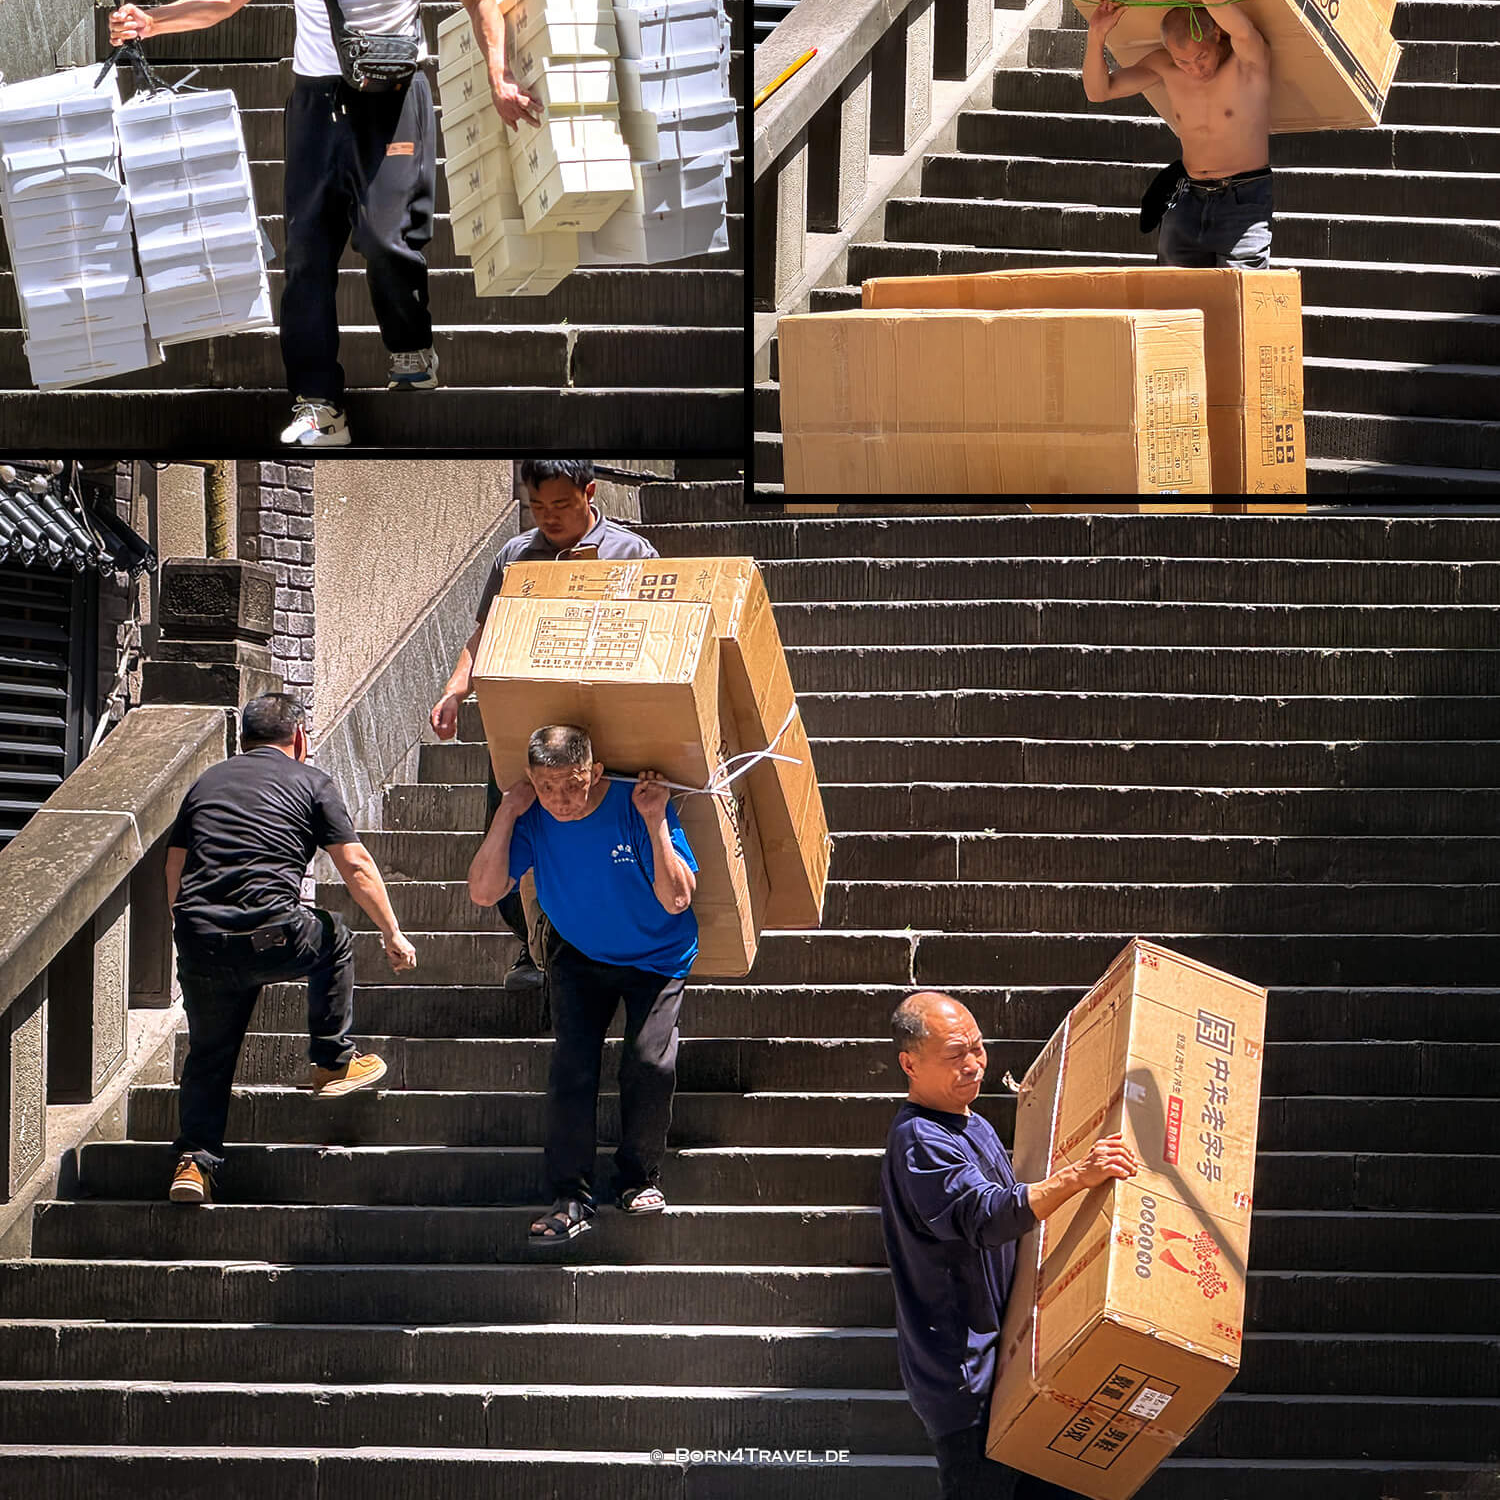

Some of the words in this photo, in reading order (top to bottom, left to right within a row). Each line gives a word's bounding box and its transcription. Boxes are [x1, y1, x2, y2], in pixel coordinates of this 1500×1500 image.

[1197, 1057, 1231, 1182] 中华老字号
[1063, 1416, 1095, 1442] 40双
